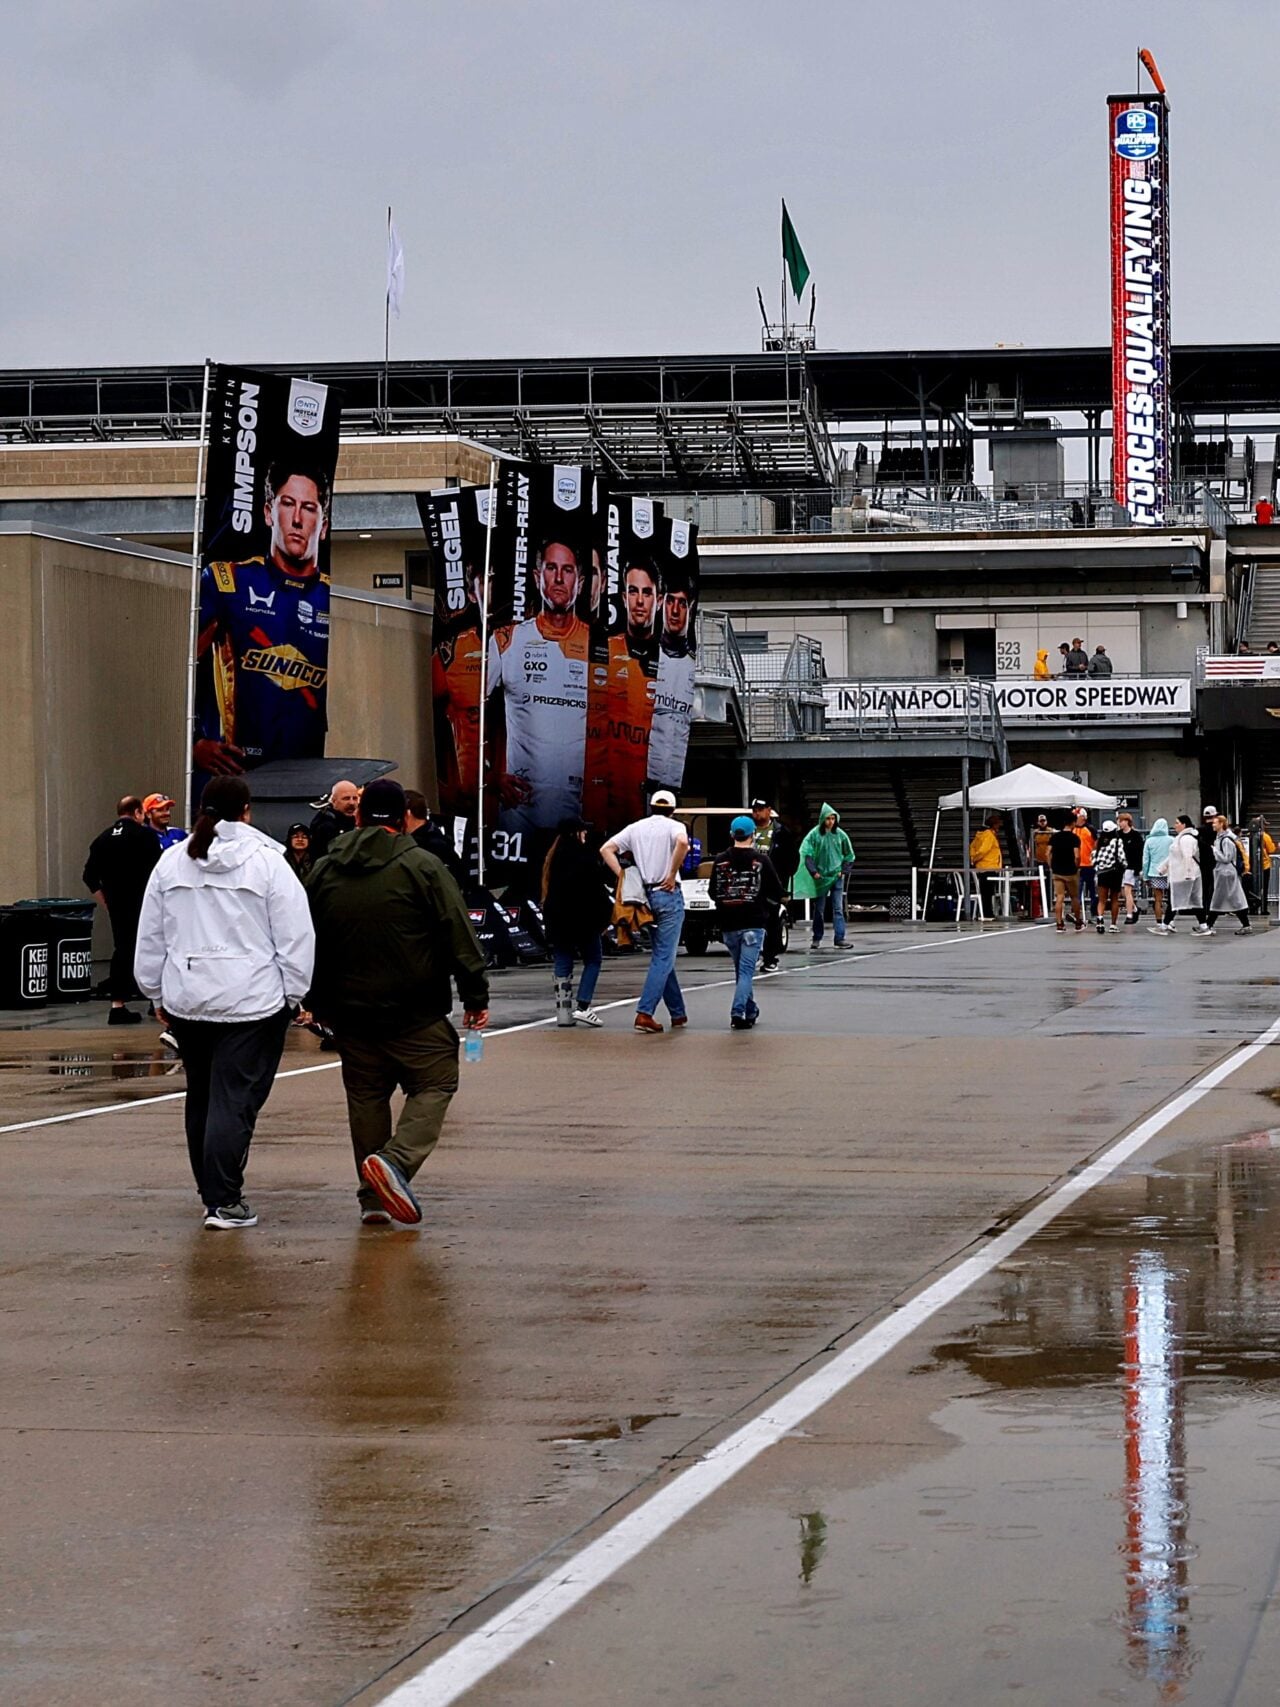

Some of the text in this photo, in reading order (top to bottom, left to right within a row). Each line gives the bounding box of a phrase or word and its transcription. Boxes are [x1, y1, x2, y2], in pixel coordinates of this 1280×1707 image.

[1123, 177, 1156, 525] FORCES QUALIFYING
[222, 379, 236, 444] KYFFIN
[231, 382, 261, 534] SIMPSON
[506, 471, 514, 506] RYAN
[428, 504, 440, 547] NOLAN
[439, 501, 466, 611] SIEGEL
[512, 472, 530, 622] HUNTER-REAY
[997, 641, 1021, 656] 523
[997, 656, 1021, 671] 524
[244, 651, 327, 687] SUNOCO
[523, 661, 548, 672] GXO
[533, 695, 587, 709] PRIZEPICKS
[837, 685, 1179, 711] INDIANAPOLIS MOTOR SPEEDWAY
[491, 830, 528, 862] 31
[29, 948, 48, 963] KEE
